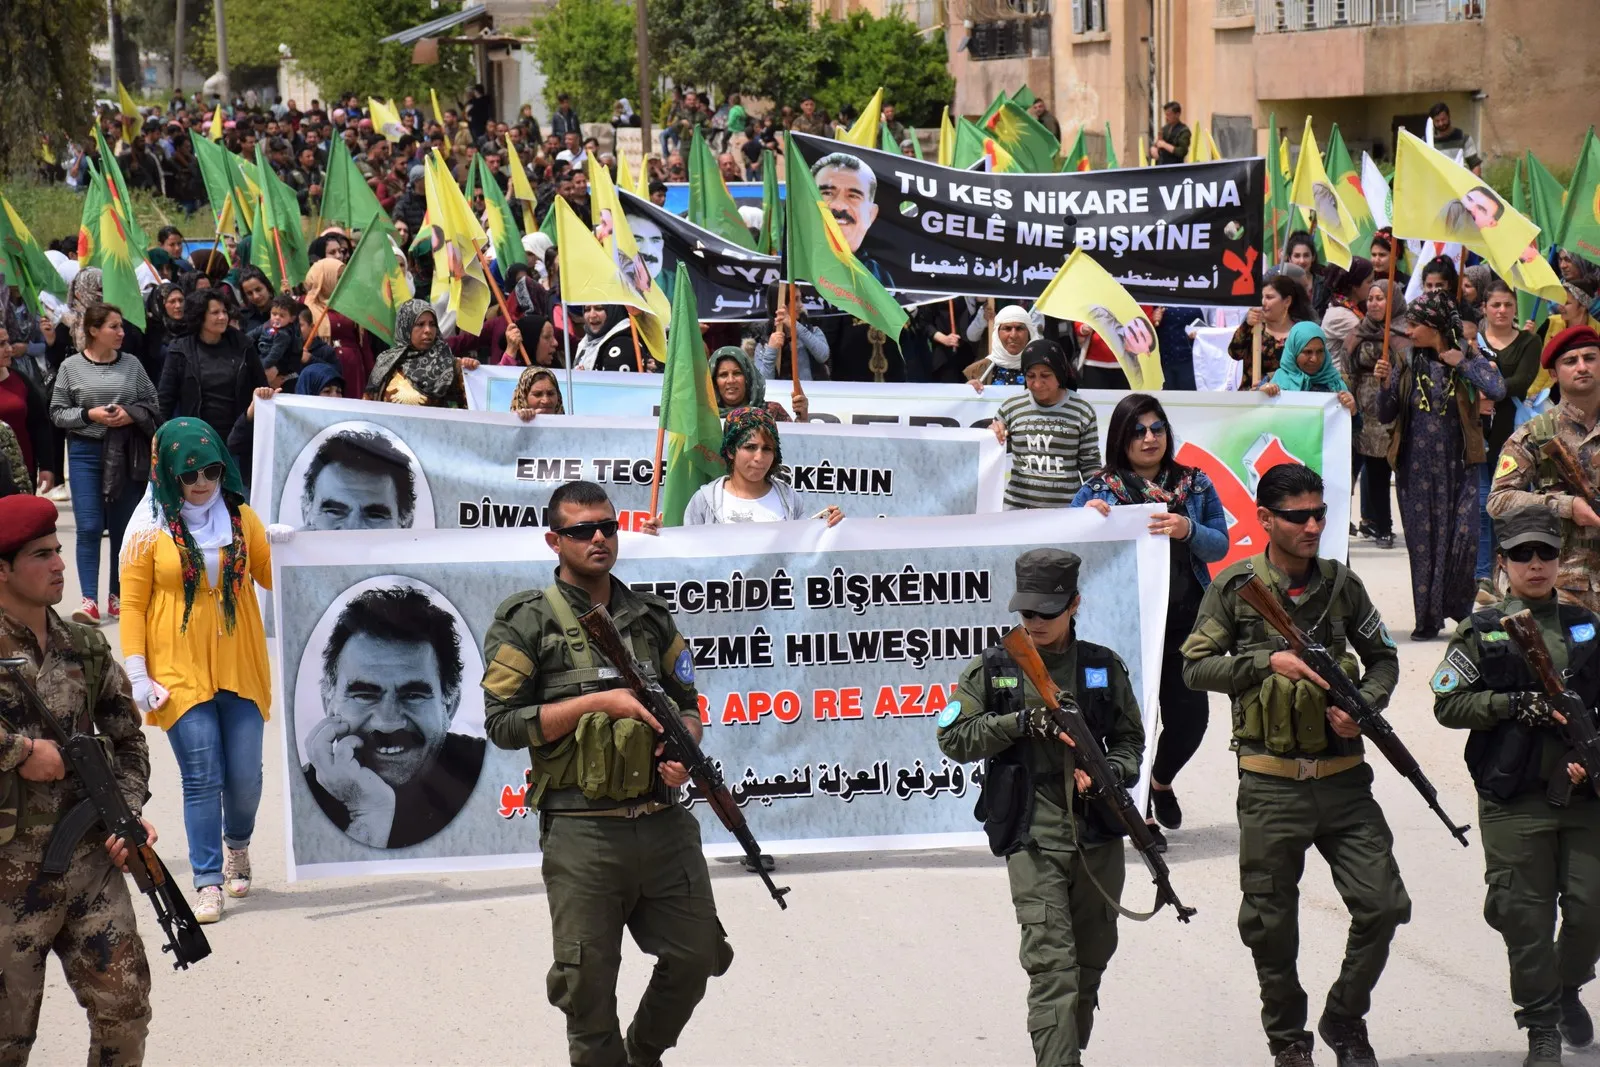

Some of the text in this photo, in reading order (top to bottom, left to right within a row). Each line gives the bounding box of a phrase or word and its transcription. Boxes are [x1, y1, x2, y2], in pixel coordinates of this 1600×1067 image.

[895, 170, 937, 198] TU
[949, 183, 1013, 210] KES
[1159, 178, 1241, 211] VÎNA
[921, 211, 1212, 258] GELÊ ME BIŞKÎNE
[910, 252, 968, 278] شعبنا
[973, 259, 1018, 285] إرادة
[1184, 265, 1219, 290] أحد
[1025, 433, 1054, 452] MY
[516, 458, 582, 480] EME
[592, 459, 667, 484] TEC
[1020, 454, 1066, 475] STYLE
[807, 564, 991, 614] BÎŞKÊNIN
[721, 690, 801, 725] APO
[813, 687, 863, 719] RE
[873, 684, 960, 717] AZA
